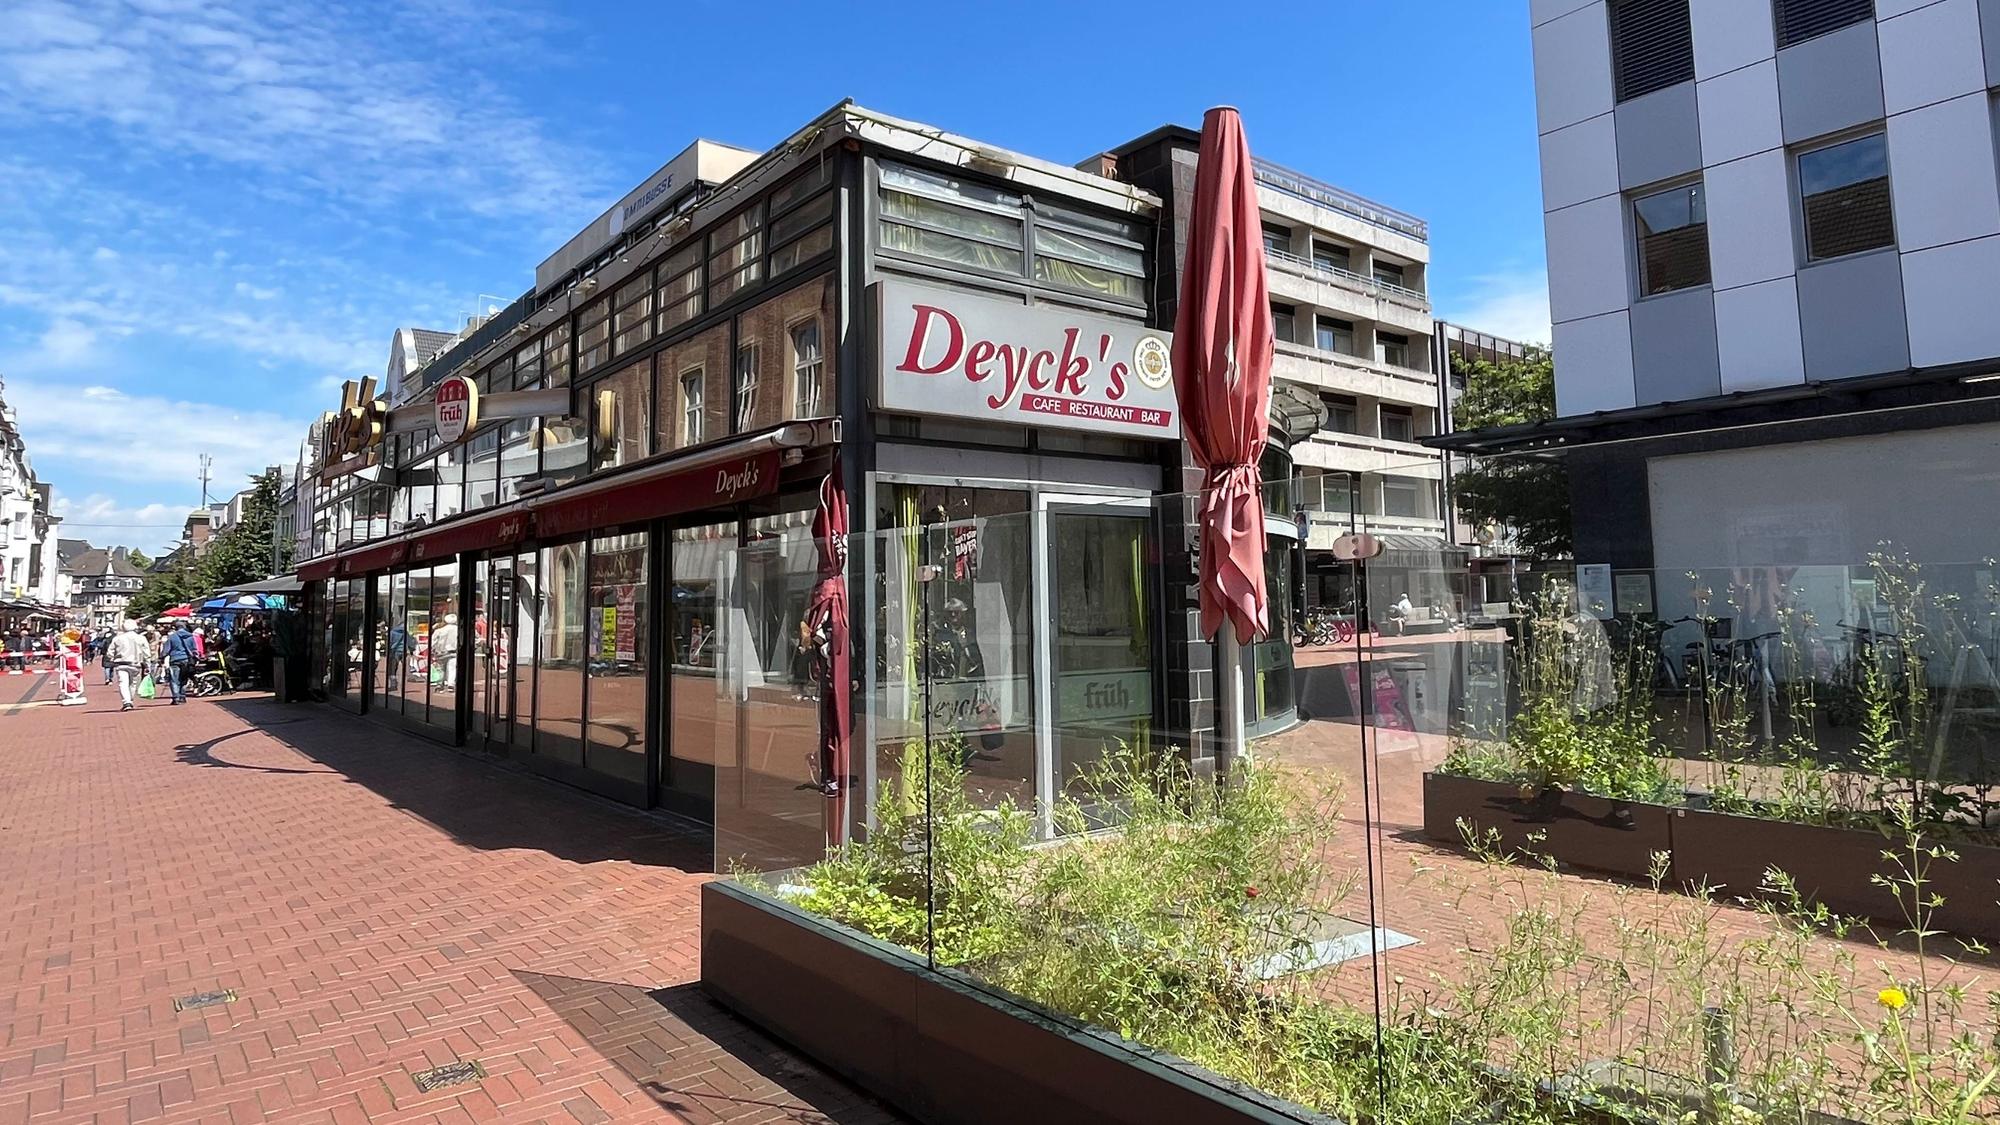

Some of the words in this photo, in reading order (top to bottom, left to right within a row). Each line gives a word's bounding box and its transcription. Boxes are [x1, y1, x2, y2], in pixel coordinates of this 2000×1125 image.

[896, 304, 1131, 410] Deyck's
[1032, 397, 1062, 413] CAFE
[1069, 402, 1134, 421] RESTAURANT
[1141, 412, 1161, 424] BAR
[715, 460, 759, 499] Deyck's
